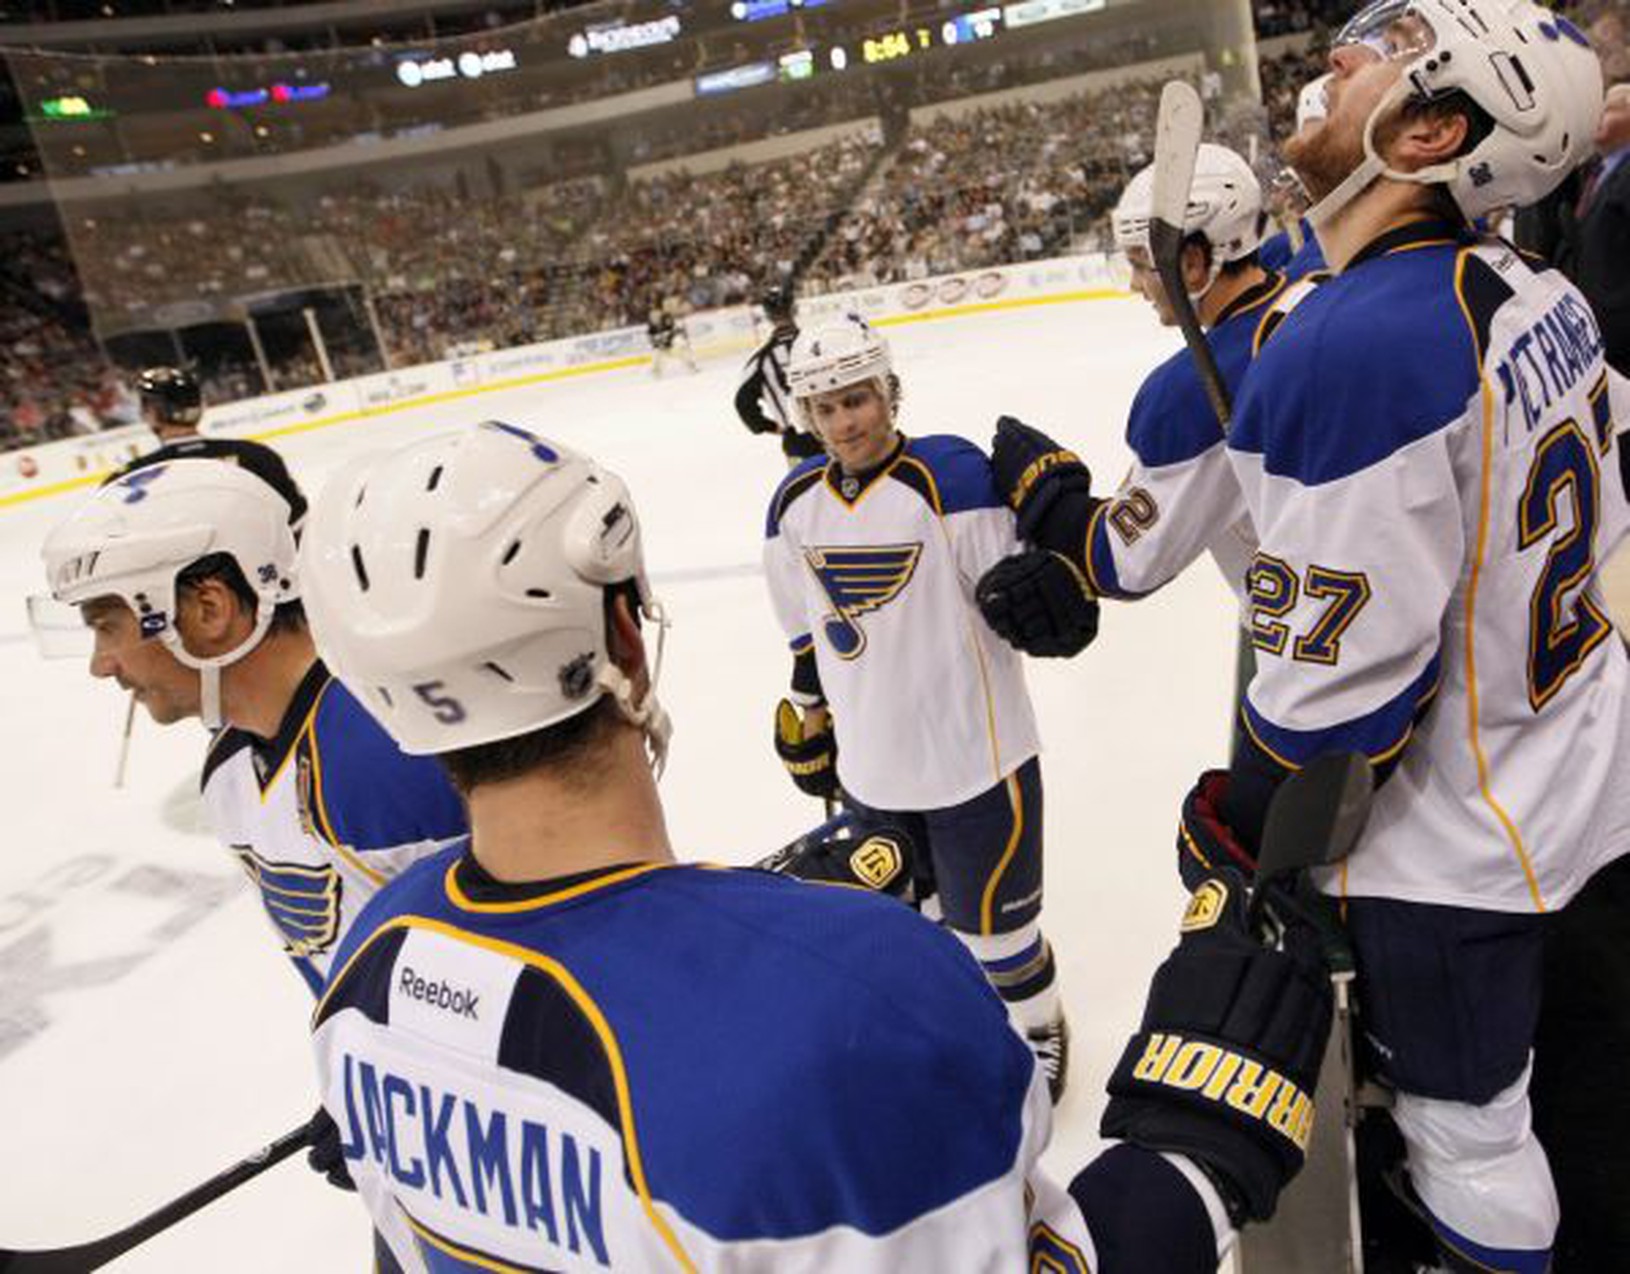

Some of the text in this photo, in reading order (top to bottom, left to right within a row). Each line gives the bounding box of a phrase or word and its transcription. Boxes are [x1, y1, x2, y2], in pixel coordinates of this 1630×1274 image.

[1247, 551, 1371, 665] 27
[412, 679, 467, 725] 5
[398, 966, 480, 1021] Reebok
[341, 1053, 612, 1268] JACKMAN
